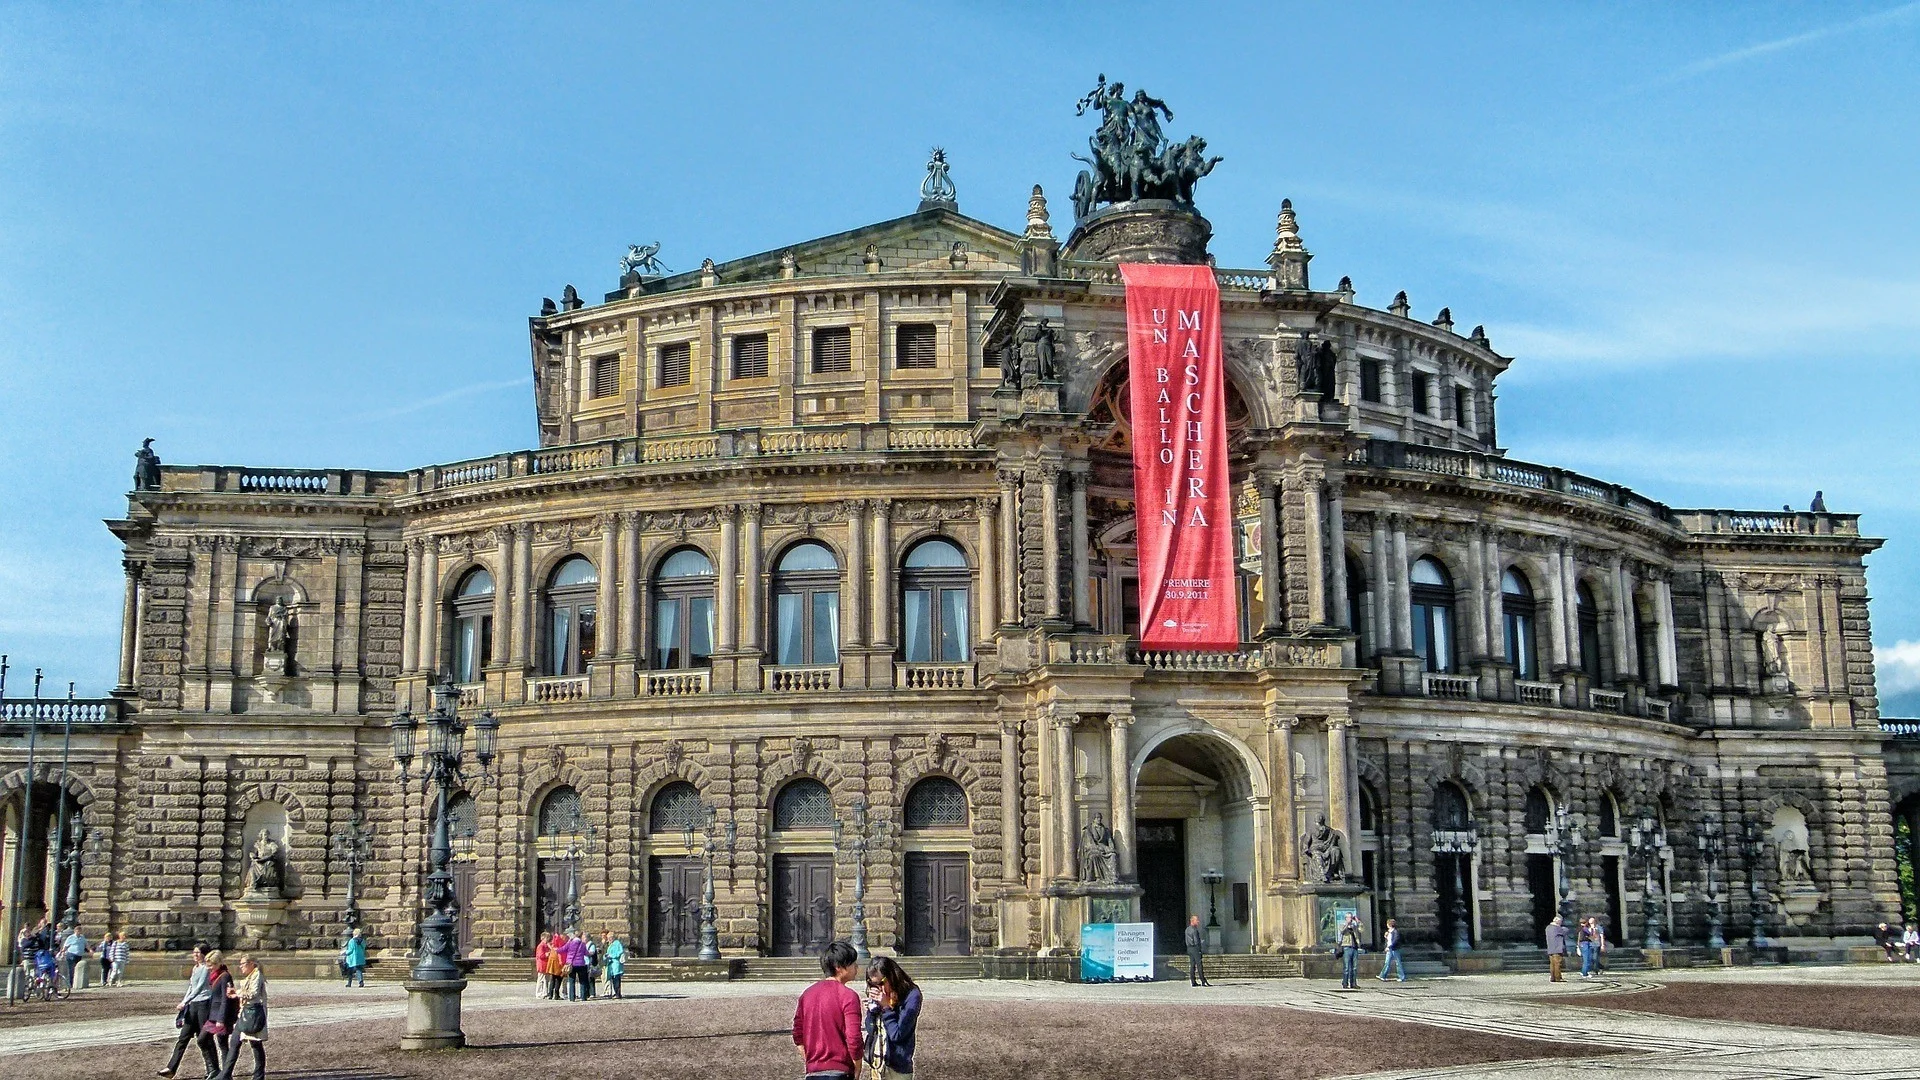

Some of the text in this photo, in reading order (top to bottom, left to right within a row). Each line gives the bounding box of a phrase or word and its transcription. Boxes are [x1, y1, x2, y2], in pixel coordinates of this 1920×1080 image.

[1152, 308, 1177, 527] UN BALLO IN
[1177, 309, 1208, 527] MASCHERA
[1163, 578, 1211, 587] PREMIERE
[1165, 590, 1208, 599] 30.9.2011
